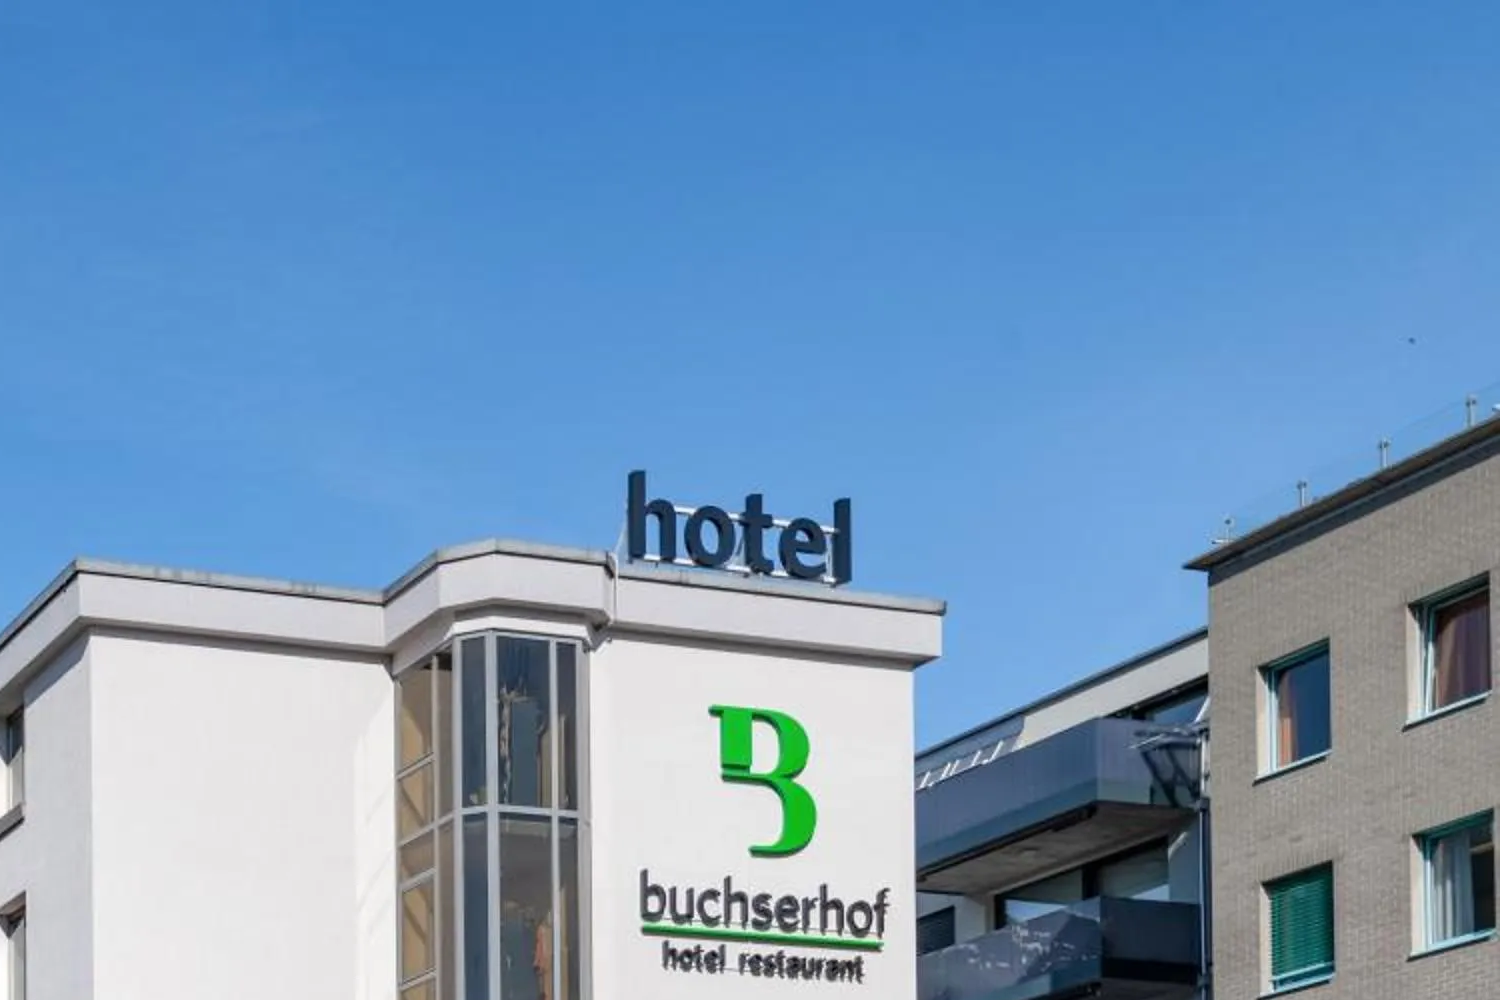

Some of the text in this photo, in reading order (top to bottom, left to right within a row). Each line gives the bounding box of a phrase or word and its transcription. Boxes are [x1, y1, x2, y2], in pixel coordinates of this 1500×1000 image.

[628, 469, 852, 586] hotel
[708, 705, 817, 858] B
[640, 868, 890, 938] buchserhof
[662, 940, 865, 984] hotel restaurant
